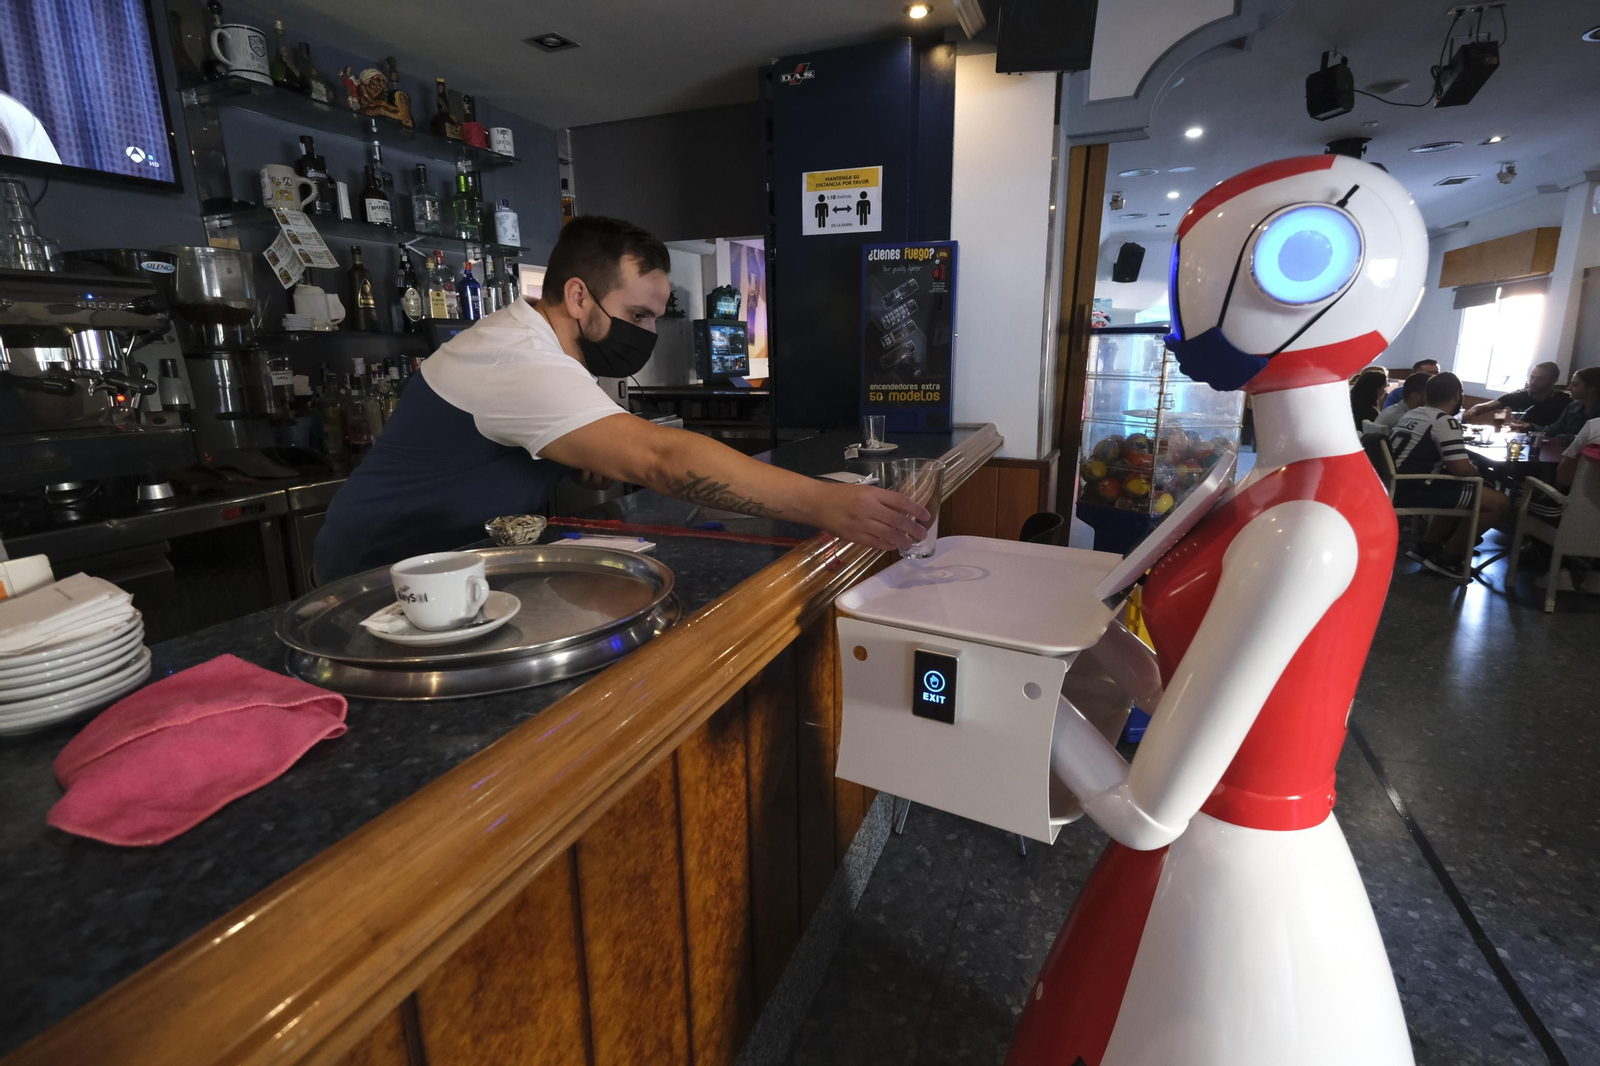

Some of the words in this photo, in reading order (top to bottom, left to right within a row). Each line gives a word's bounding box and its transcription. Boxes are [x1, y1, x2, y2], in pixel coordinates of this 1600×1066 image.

[904, 247, 935, 262] fuego?
[869, 391, 884, 402] 50
[888, 390, 941, 402] modelos
[667, 470, 783, 518] Alberto
[922, 691, 946, 704] EXIT
